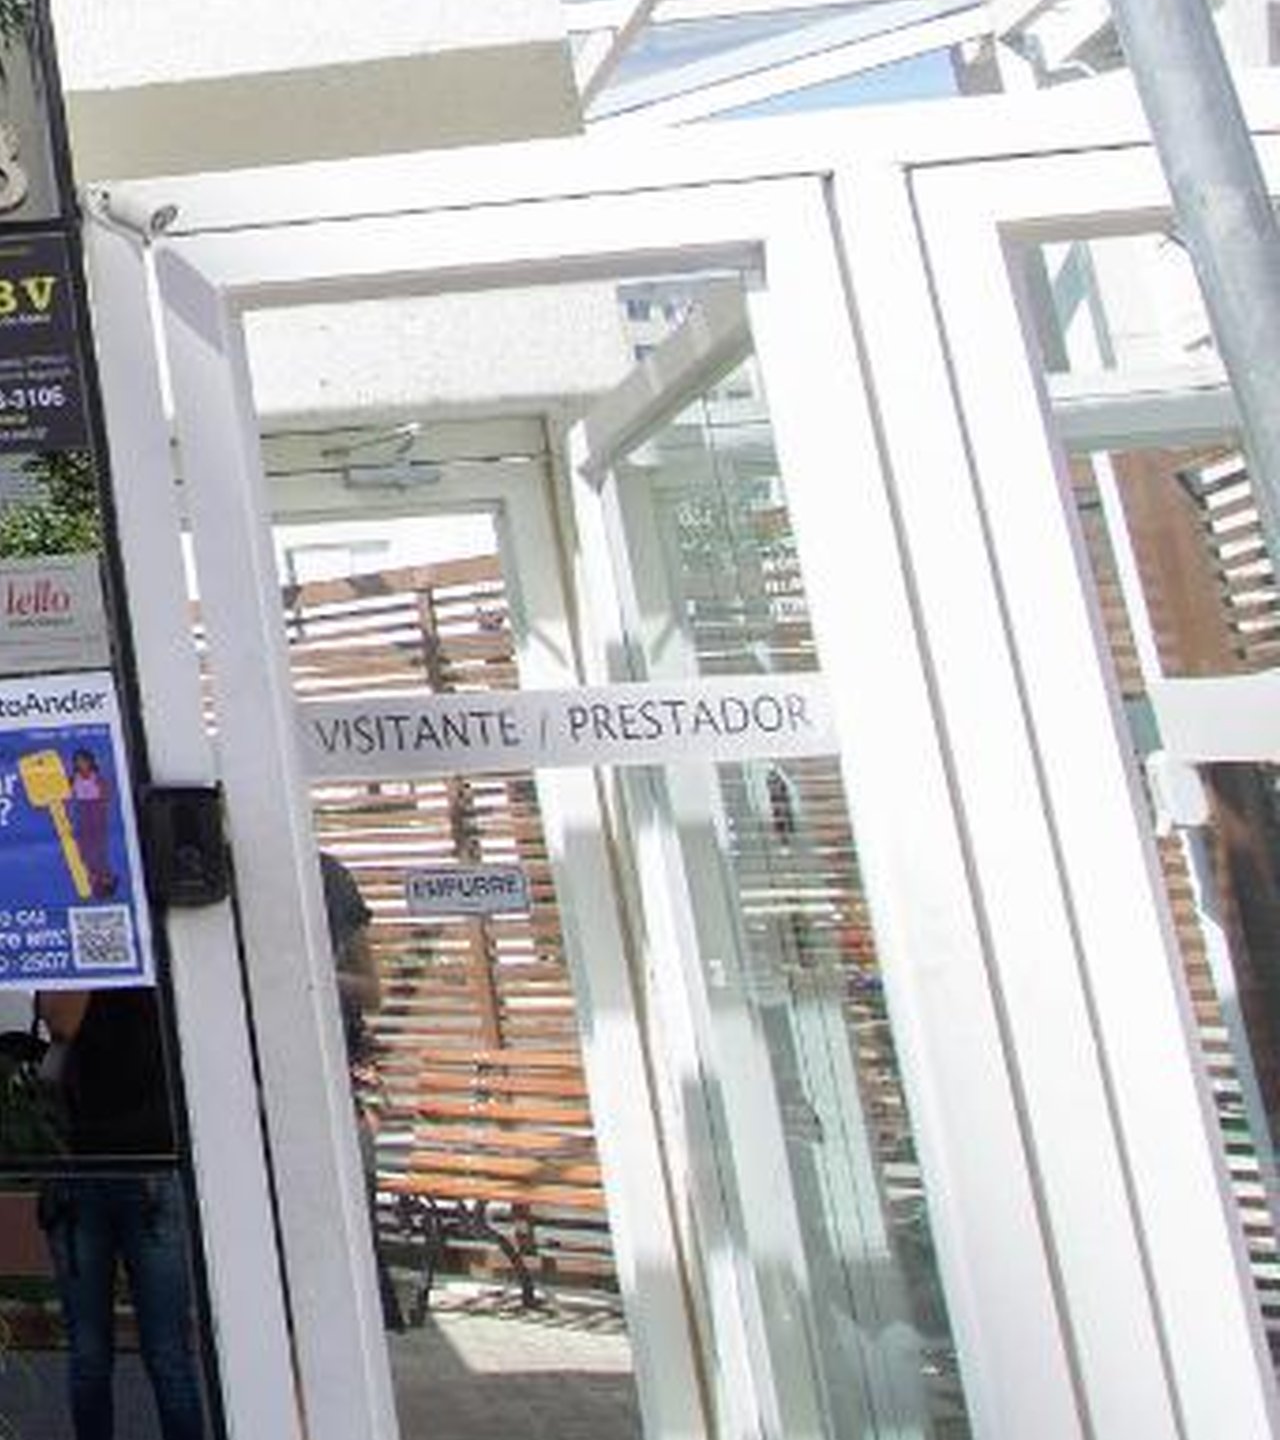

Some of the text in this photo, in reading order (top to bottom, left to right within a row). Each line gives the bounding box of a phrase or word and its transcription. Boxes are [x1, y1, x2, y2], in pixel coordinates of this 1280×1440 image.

[6, 580, 70, 616] lello
[315, 710, 521, 755] VISITANTE
[568, 693, 813, 742] PRESTADOR
